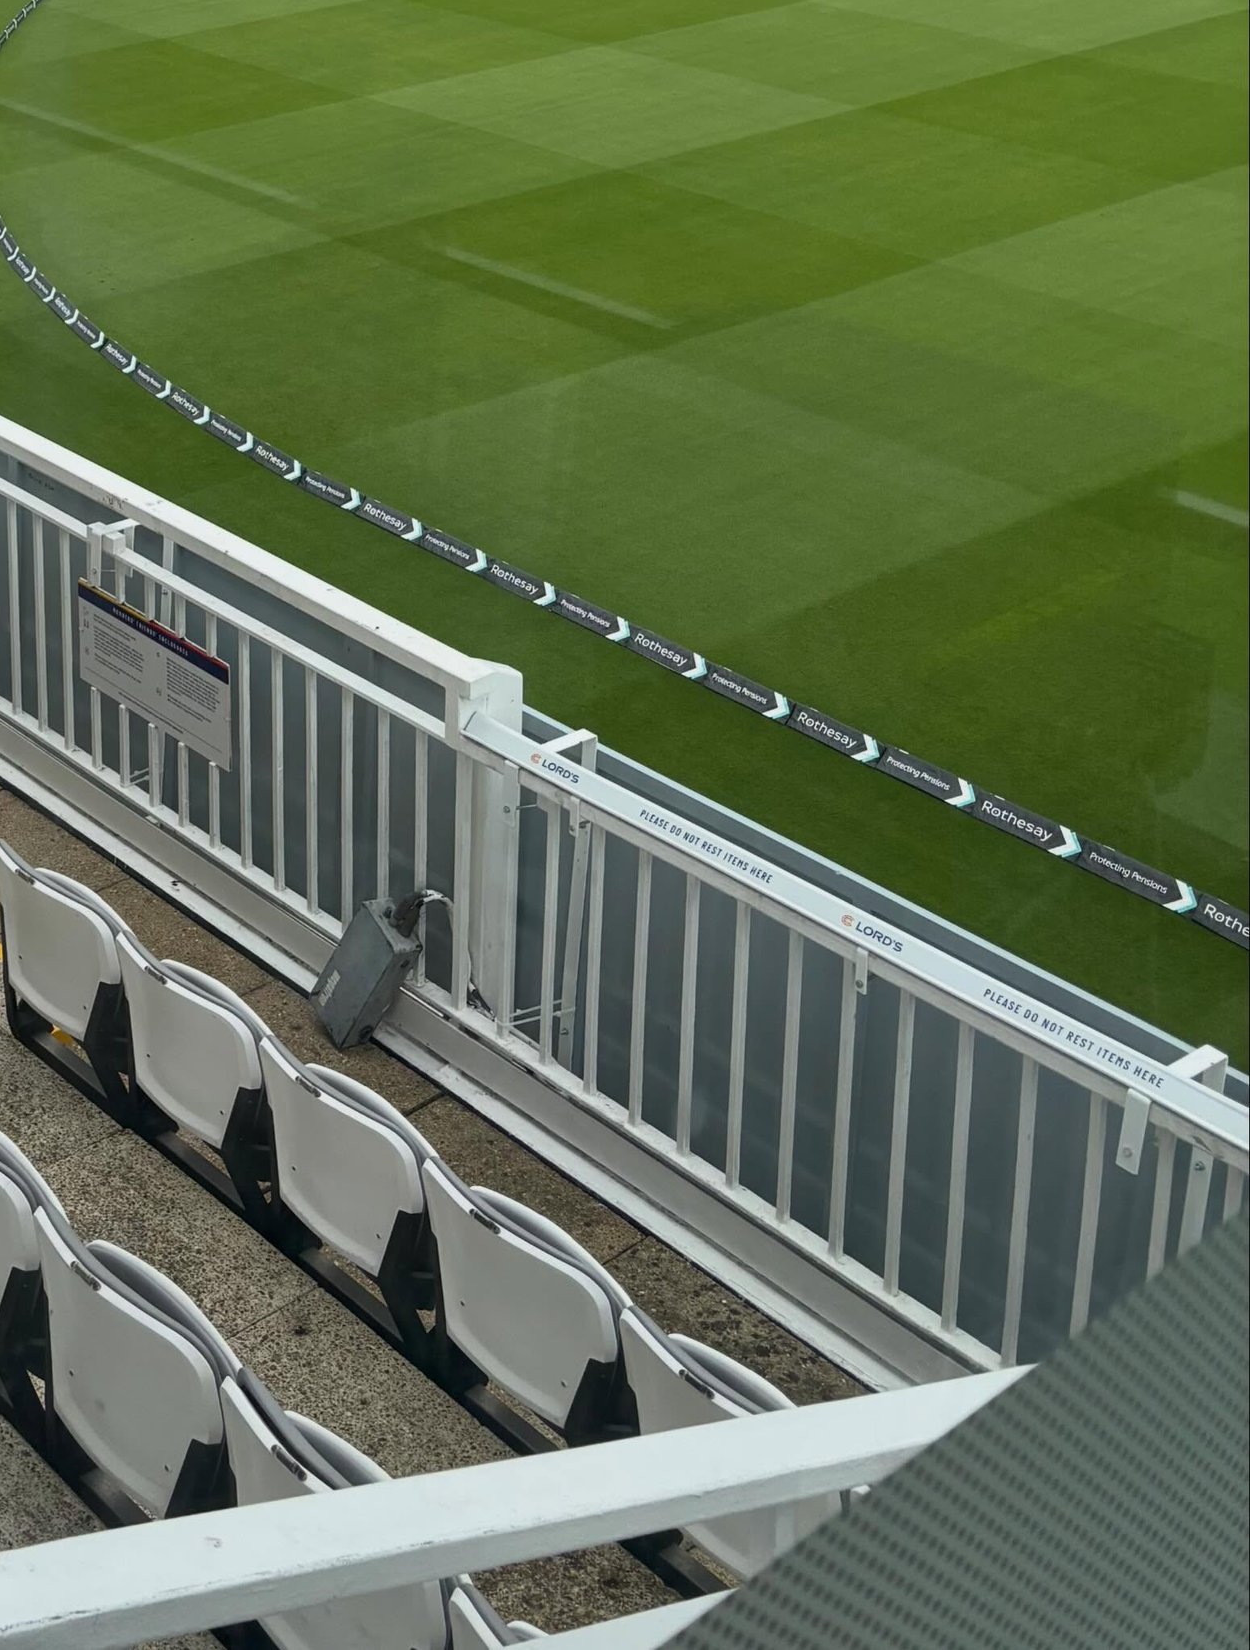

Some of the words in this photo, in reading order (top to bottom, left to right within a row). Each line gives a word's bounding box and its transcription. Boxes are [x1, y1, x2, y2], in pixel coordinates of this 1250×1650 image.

[256, 445, 290, 471] Rothesay
[364, 503, 407, 531] Rothesay
[425, 534, 449, 552] Protecting
[490, 564, 539, 596] Rothesay
[560, 599, 587, 618] Protecting
[587, 612, 612, 628] Pensions
[634, 632, 688, 667] Rothesay
[712, 672, 741, 694] Protecting
[742, 686, 768, 706] Pensions
[797, 711, 857, 749] Rothesay
[542, 759, 580, 784] LORD'S
[886, 756, 920, 778] Protecting
[920, 771, 950, 791] Pensions
[981, 800, 1053, 842] Rothesay
[640, 809, 669, 831] PLEASE
[670, 825, 682, 837] DO
[683, 832, 700, 847] NOT
[702, 841, 723, 858] REST
[723, 852, 750, 872] ITEMS
[750, 866, 774, 884] HERE
[1090, 852, 1130, 878] Protecting
[1132, 871, 1168, 895] Pensions
[855, 920, 904, 953] LORD'S
[1204, 903, 1249, 938] Rothe
[983, 988, 1021, 1015] PLEASE
[1023, 1008, 1039, 1023] DO
[1042, 1018, 1065, 1036] NOT
[1066, 1030, 1095, 1052] REST
[1097, 1046, 1132, 1071] ITEMS
[1134, 1066, 1166, 1090] HERE
